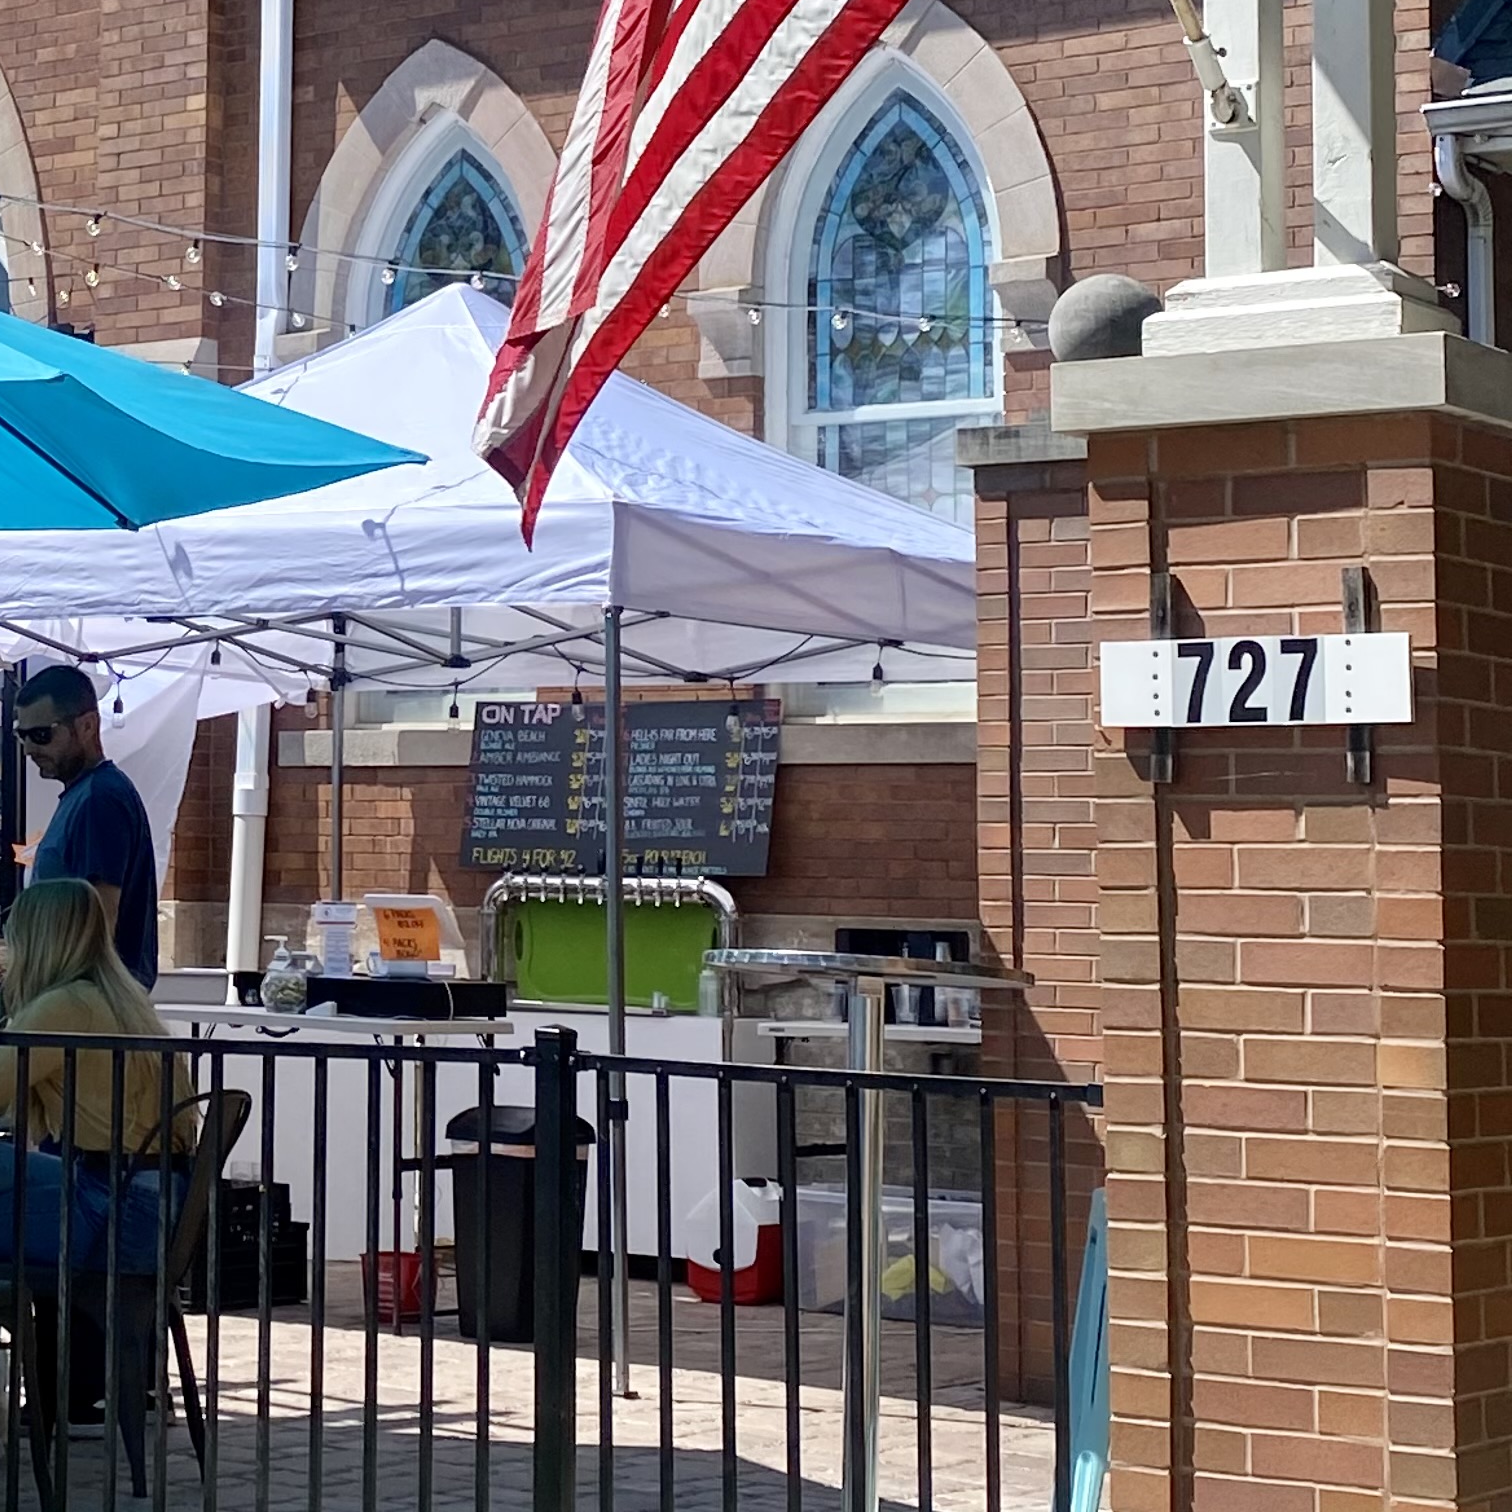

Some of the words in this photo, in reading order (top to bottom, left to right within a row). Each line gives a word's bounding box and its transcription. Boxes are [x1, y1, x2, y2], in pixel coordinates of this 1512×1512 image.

[1177, 638, 1318, 724] 727
[481, 705, 515, 725] ON
[519, 703, 561, 725] TAP
[538, 796, 550, 808] 68
[473, 848, 517, 865] FLIGHTS
[532, 849, 555, 865] FOR
